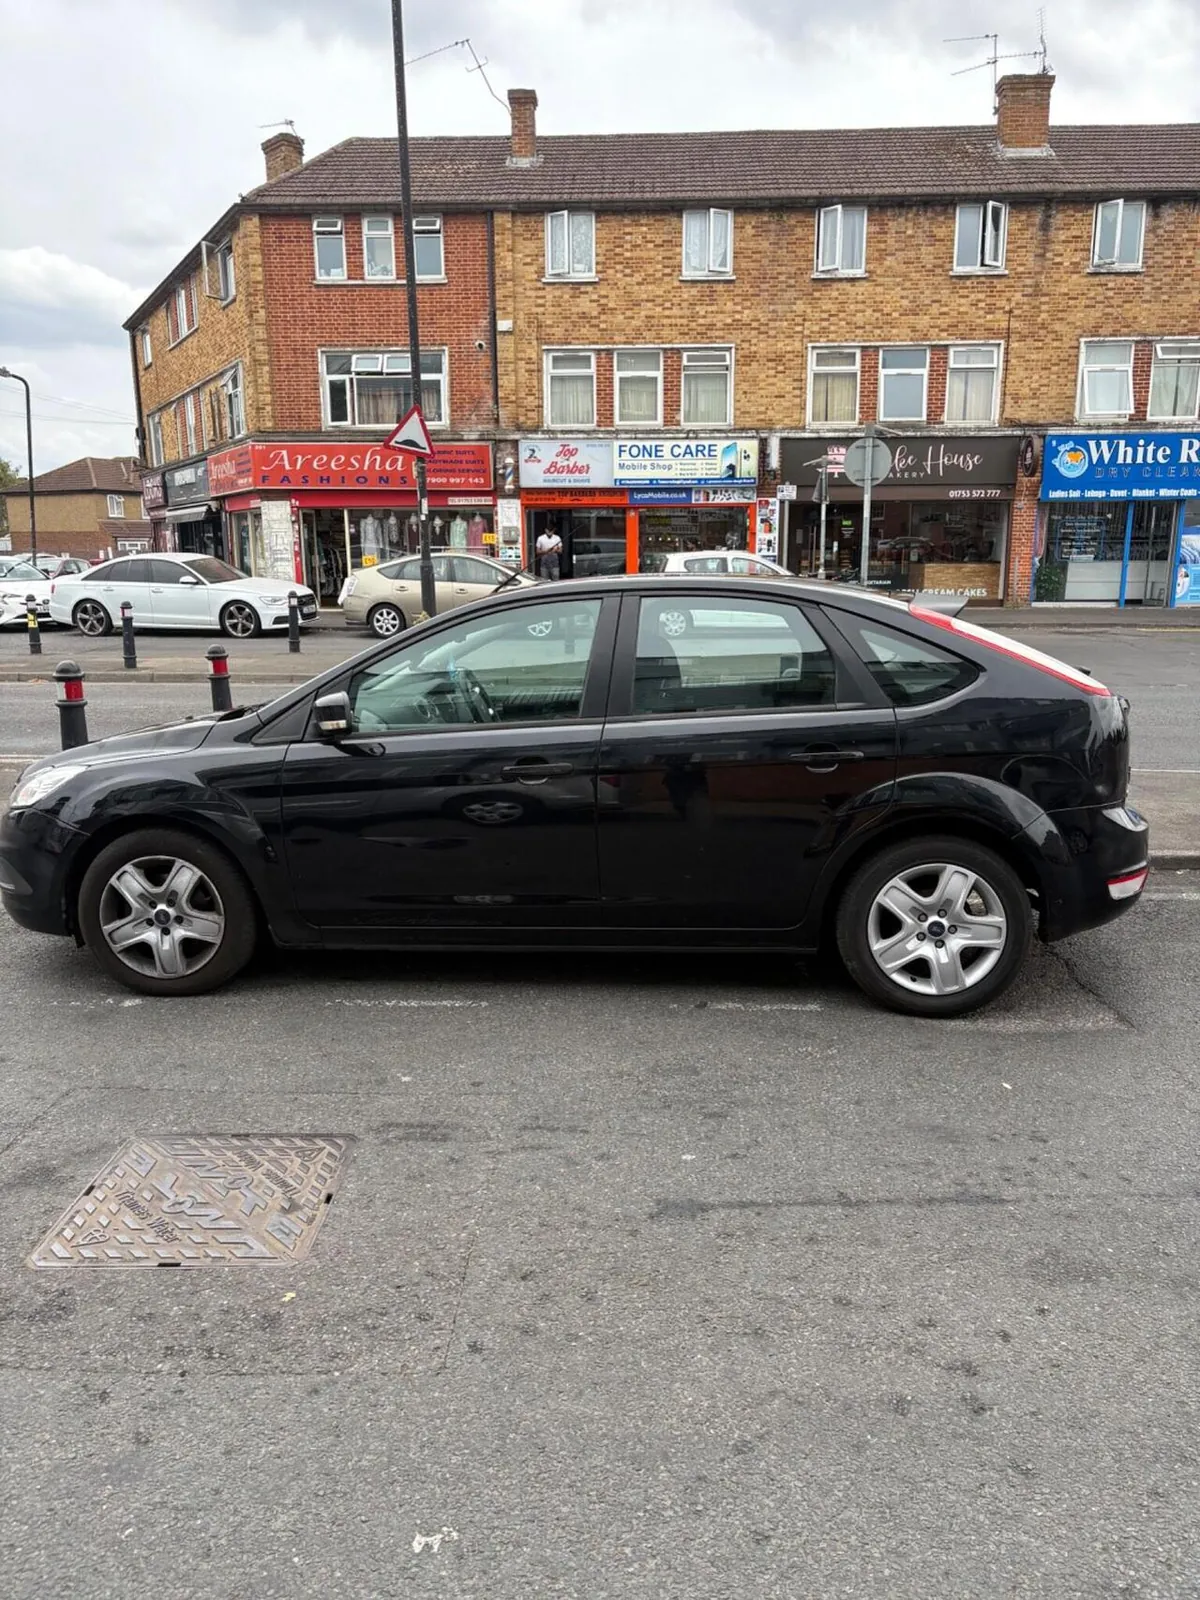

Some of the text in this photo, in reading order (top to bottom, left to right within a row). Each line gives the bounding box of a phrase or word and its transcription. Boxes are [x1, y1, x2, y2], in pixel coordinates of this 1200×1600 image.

[555, 444, 579, 457] Top
[618, 444, 718, 458] FONE CARE
[1087, 438, 1200, 464] White R
[261, 447, 407, 471] Areesha
[892, 444, 983, 476] ke House
[543, 461, 592, 474] Barber
[618, 462, 648, 471] Mobile
[650, 462, 673, 471] Shop
[1095, 466, 1200, 478] DRY CLEAN
[261, 475, 407, 484] FASHIONS
[633, 491, 687, 500] LycaMobile.co.uk
[949, 489, 1001, 498] 01753 572 777
[957, 588, 987, 597] CAKES
